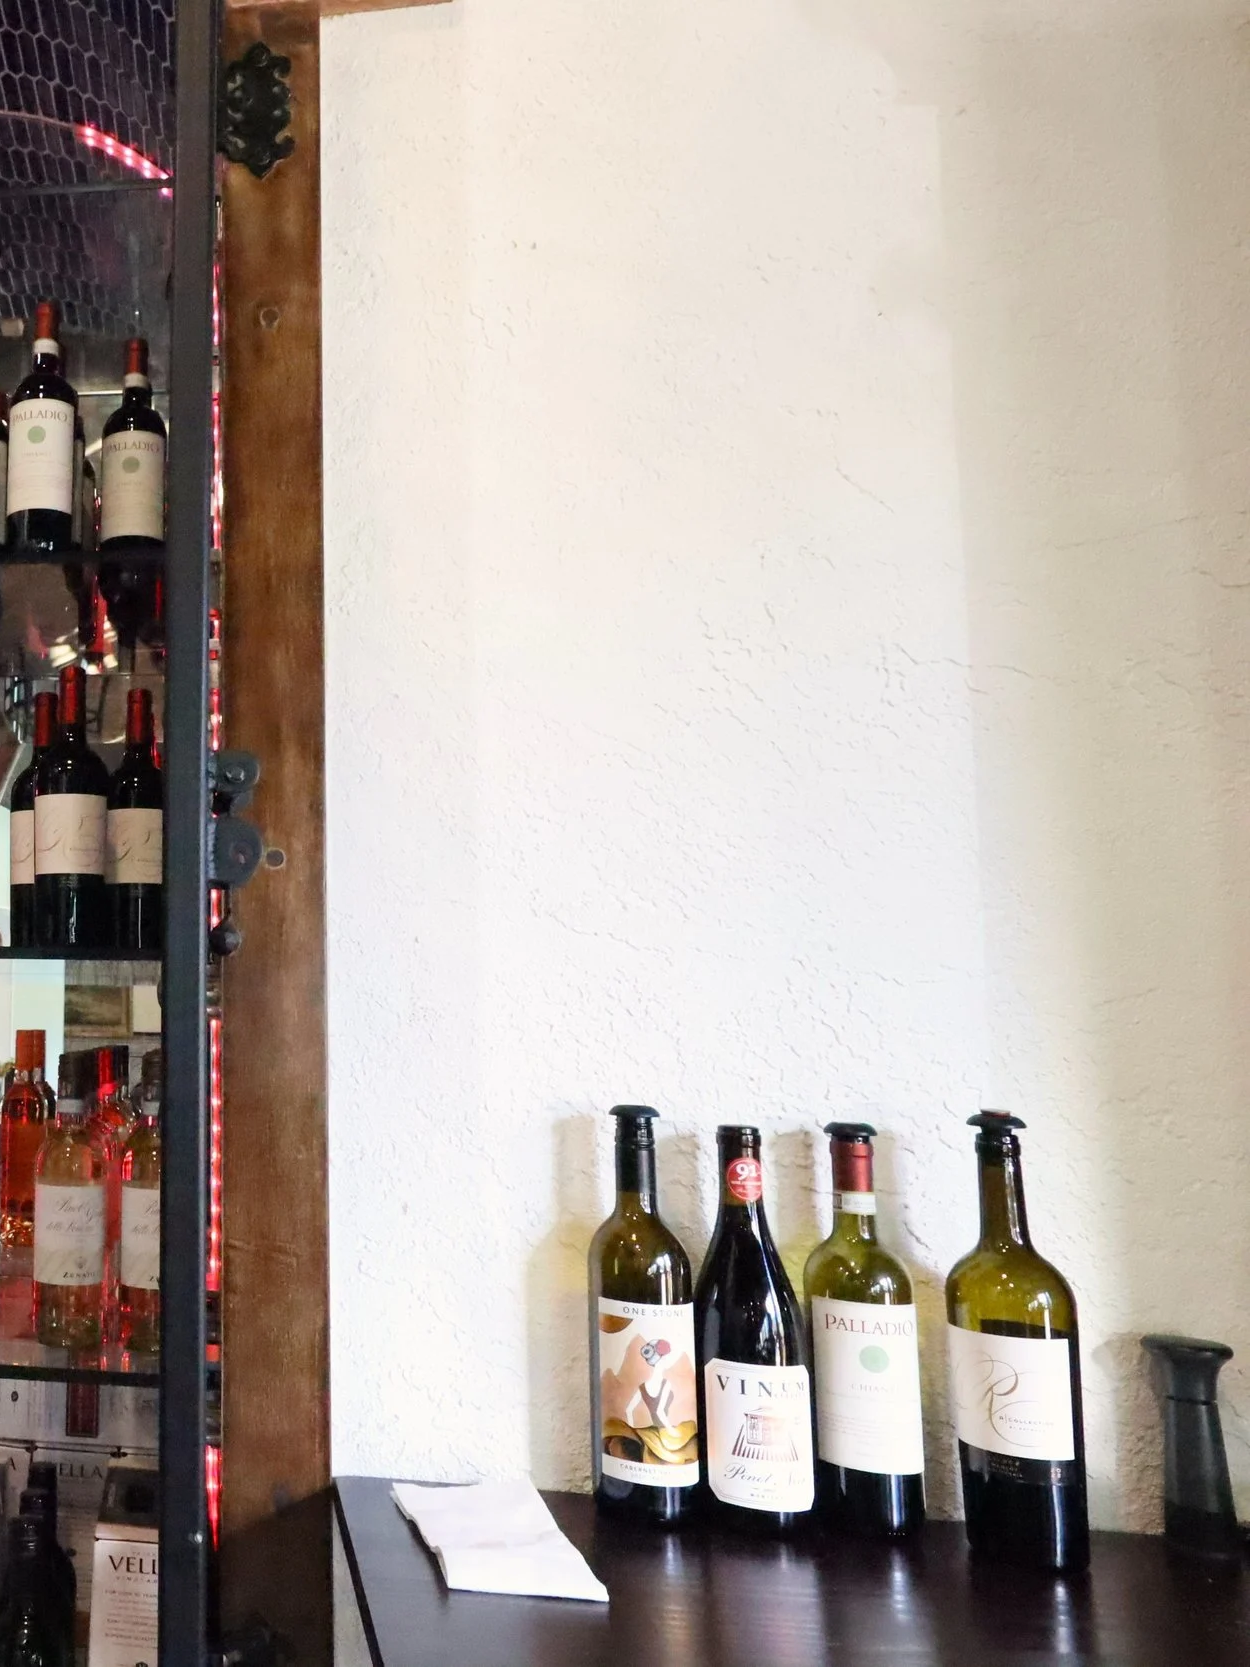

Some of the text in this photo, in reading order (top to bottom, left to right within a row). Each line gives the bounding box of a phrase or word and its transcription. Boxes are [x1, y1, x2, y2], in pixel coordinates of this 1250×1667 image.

[11, 409, 68, 422] PALLADIO
[106, 441, 159, 453] PALLADIO
[735, 1162, 758, 1181] 91
[623, 1306, 646, 1316] ONE
[824, 1312, 915, 1337] PALLADIO
[716, 1374, 805, 1397] VINUM
[59, 1463, 103, 1479] ELLA
[108, 1554, 158, 1575] VELL
